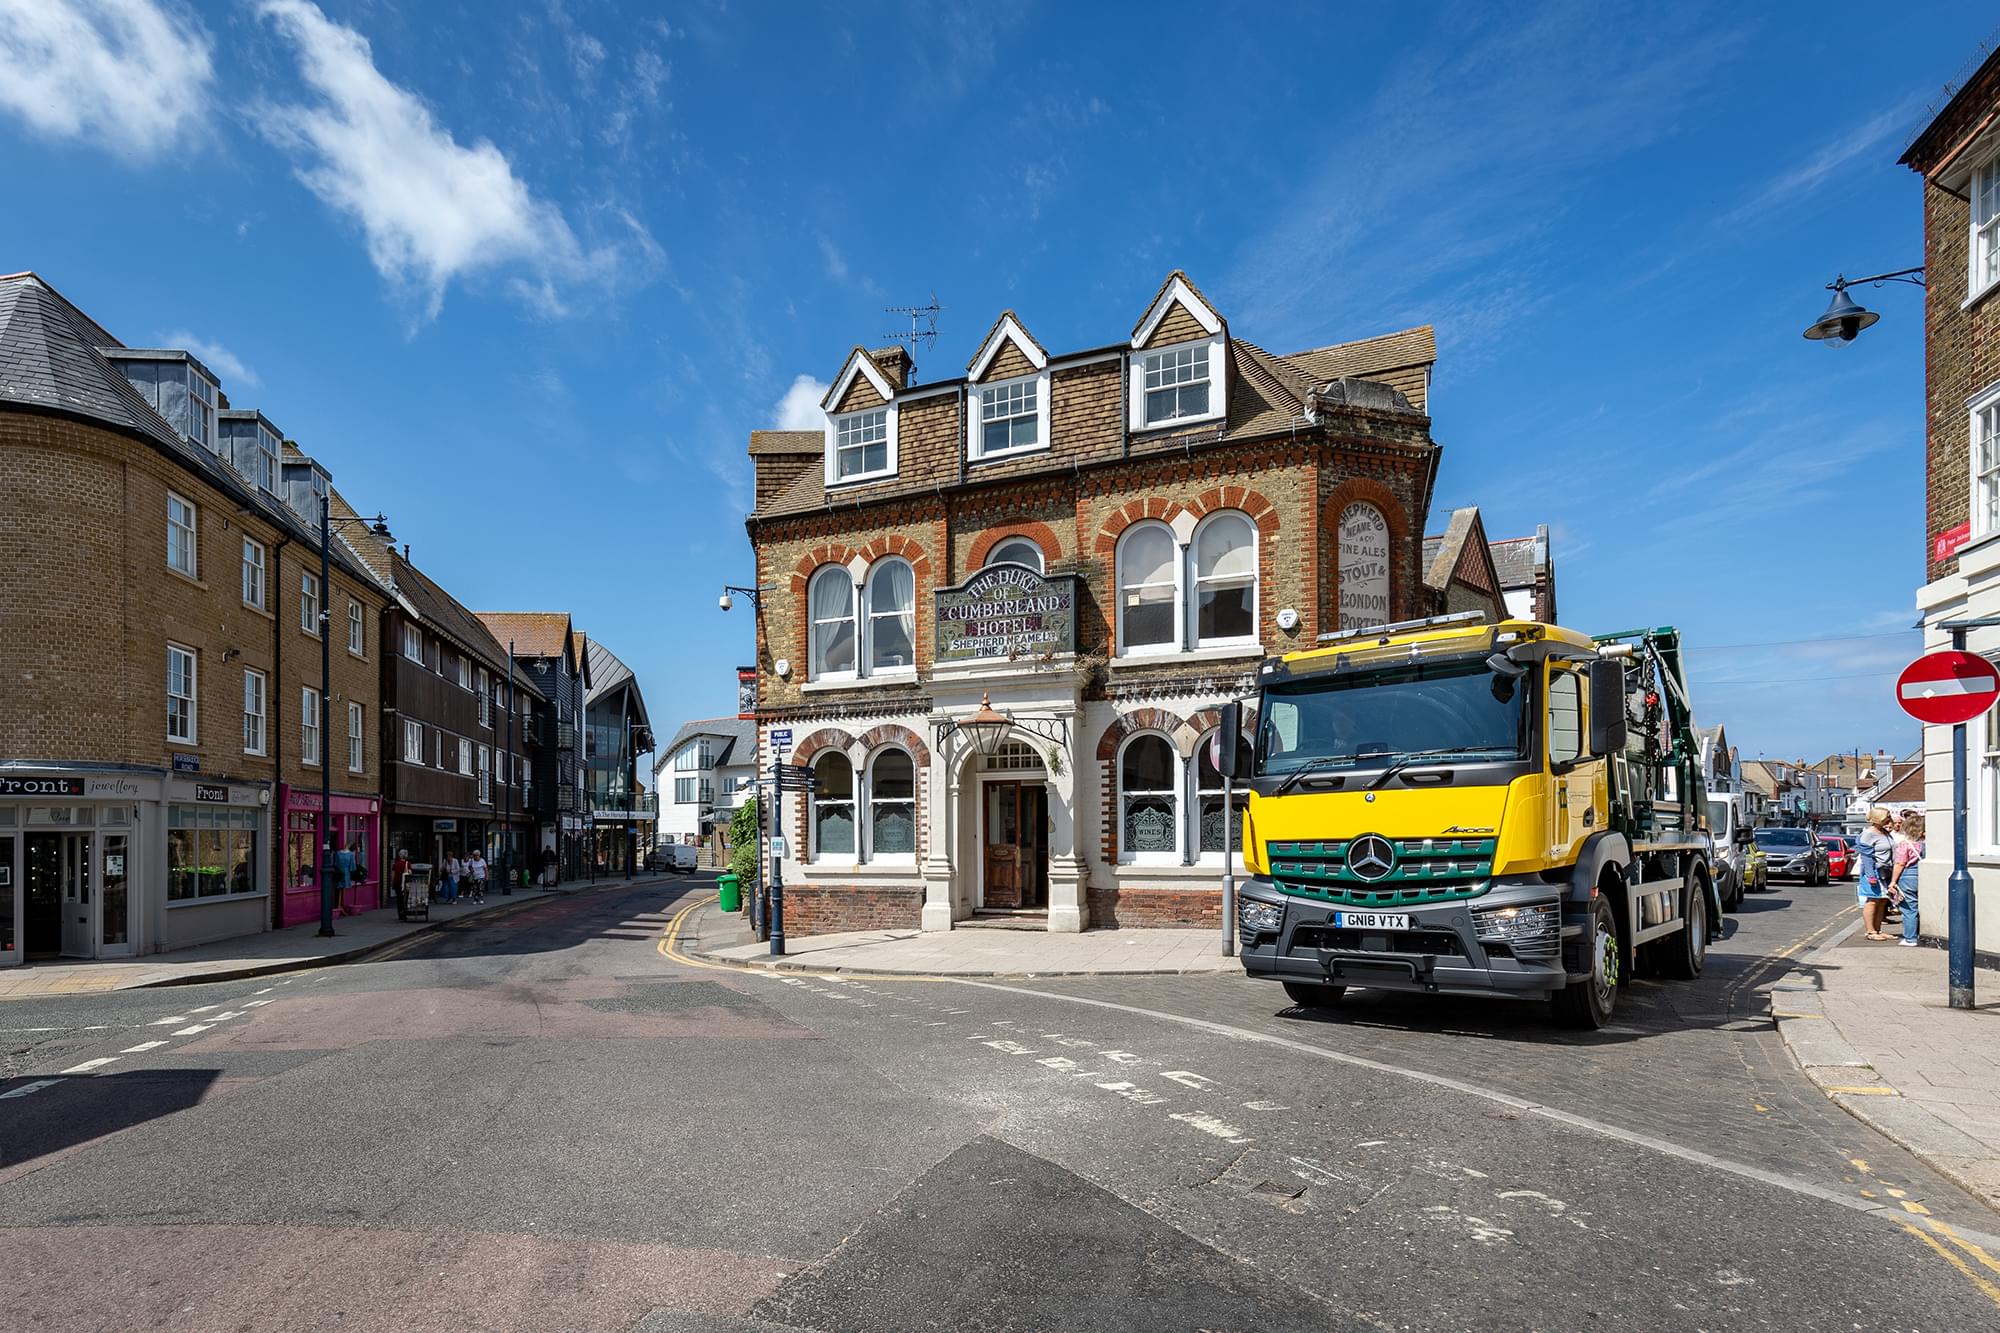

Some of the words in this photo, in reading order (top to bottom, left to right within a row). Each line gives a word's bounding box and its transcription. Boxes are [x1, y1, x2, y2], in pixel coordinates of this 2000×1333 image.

[1339, 504, 1384, 531] SHEPHERD
[1347, 522, 1371, 538] NEAME
[1361, 547, 1386, 557] ALES
[1339, 563, 1377, 584] STOUT
[1378, 565, 1385, 576] &
[967, 573, 997, 598] THE
[999, 569, 1041, 594] DUKE
[994, 587, 1010, 600] OF
[1340, 589, 1386, 611] LONDON
[948, 596, 1059, 619] CUMBERLAND
[977, 618, 1031, 636] HOTEL
[953, 636, 1004, 649] SHEPHERD
[1007, 633, 1042, 644] NEAME
[976, 646, 998, 656] FINE
[1002, 643, 1030, 656] AES.
[89, 778, 138, 795] jewellery
[197, 786, 223, 800] Front
[1348, 914, 1375, 926] GN18
[1379, 915, 1404, 928] VTX
